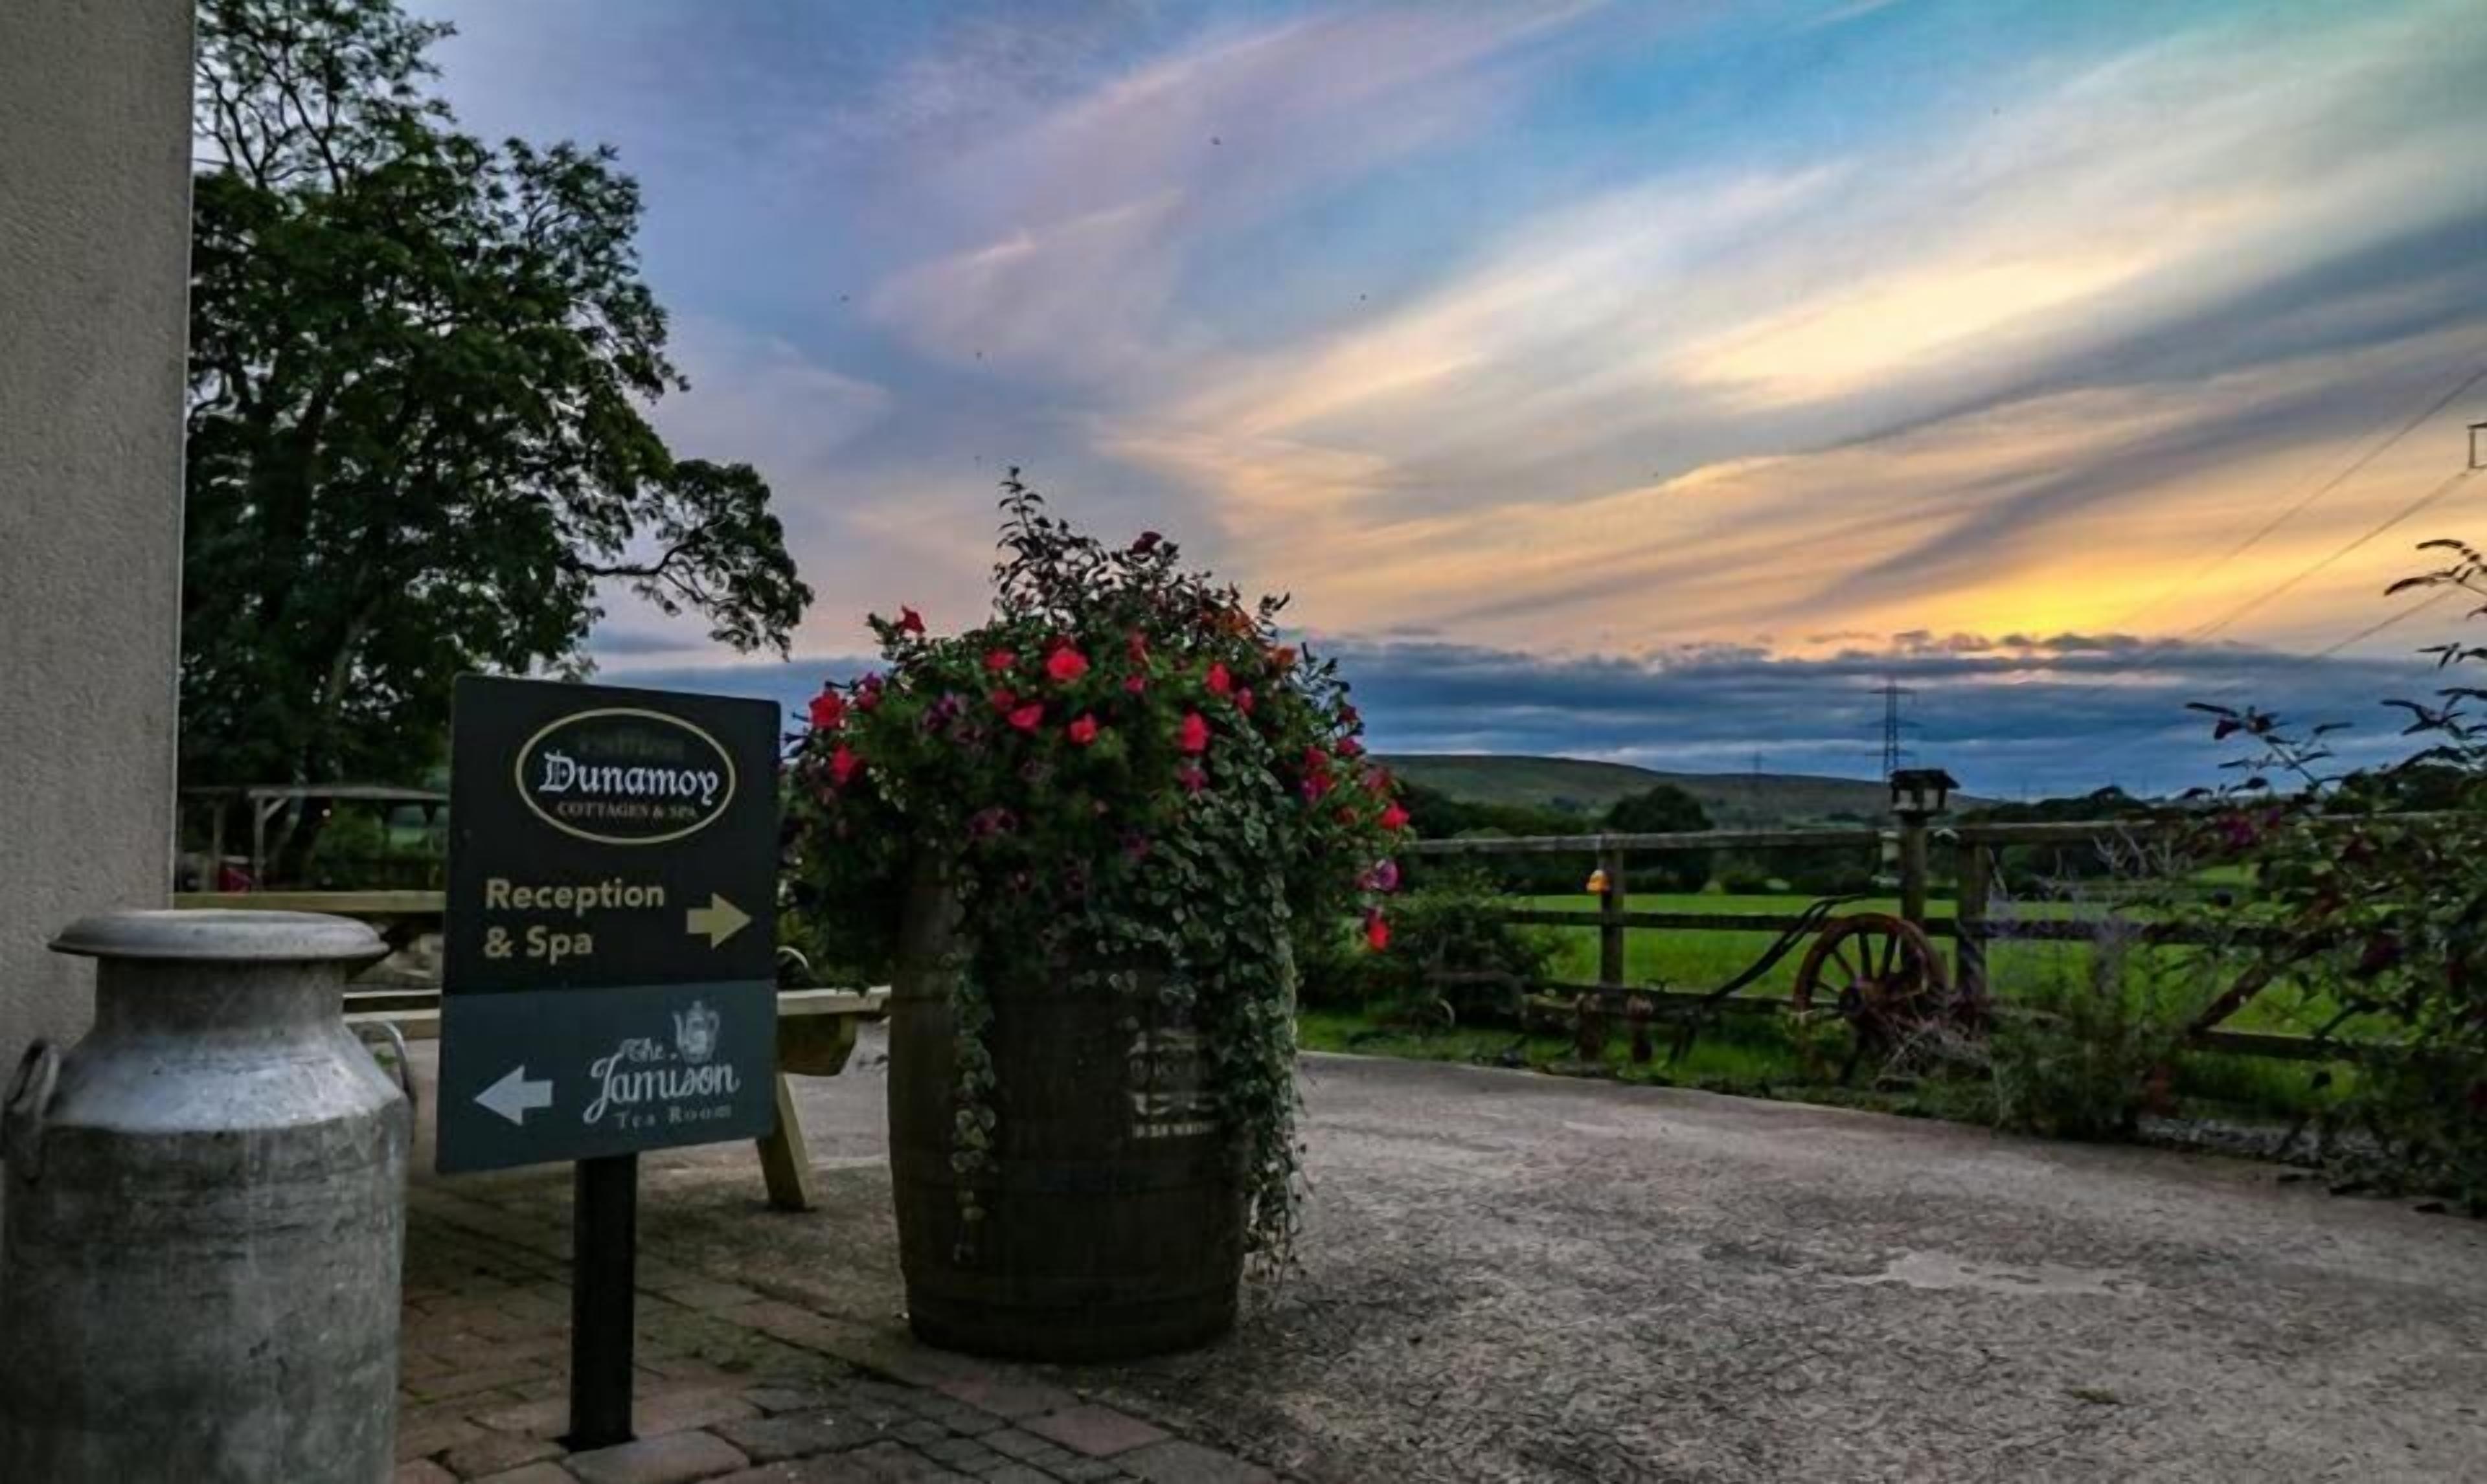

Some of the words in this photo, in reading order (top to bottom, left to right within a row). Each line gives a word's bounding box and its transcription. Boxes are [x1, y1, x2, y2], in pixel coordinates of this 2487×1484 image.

[538, 749, 720, 805] Dunamoy
[557, 800, 648, 818] COTTAGES
[485, 877, 664, 917] Reception
[484, 927, 513, 958] &
[526, 925, 593, 965] Spa
[619, 1037, 664, 1063] The
[582, 1051, 742, 1125] Jamison
